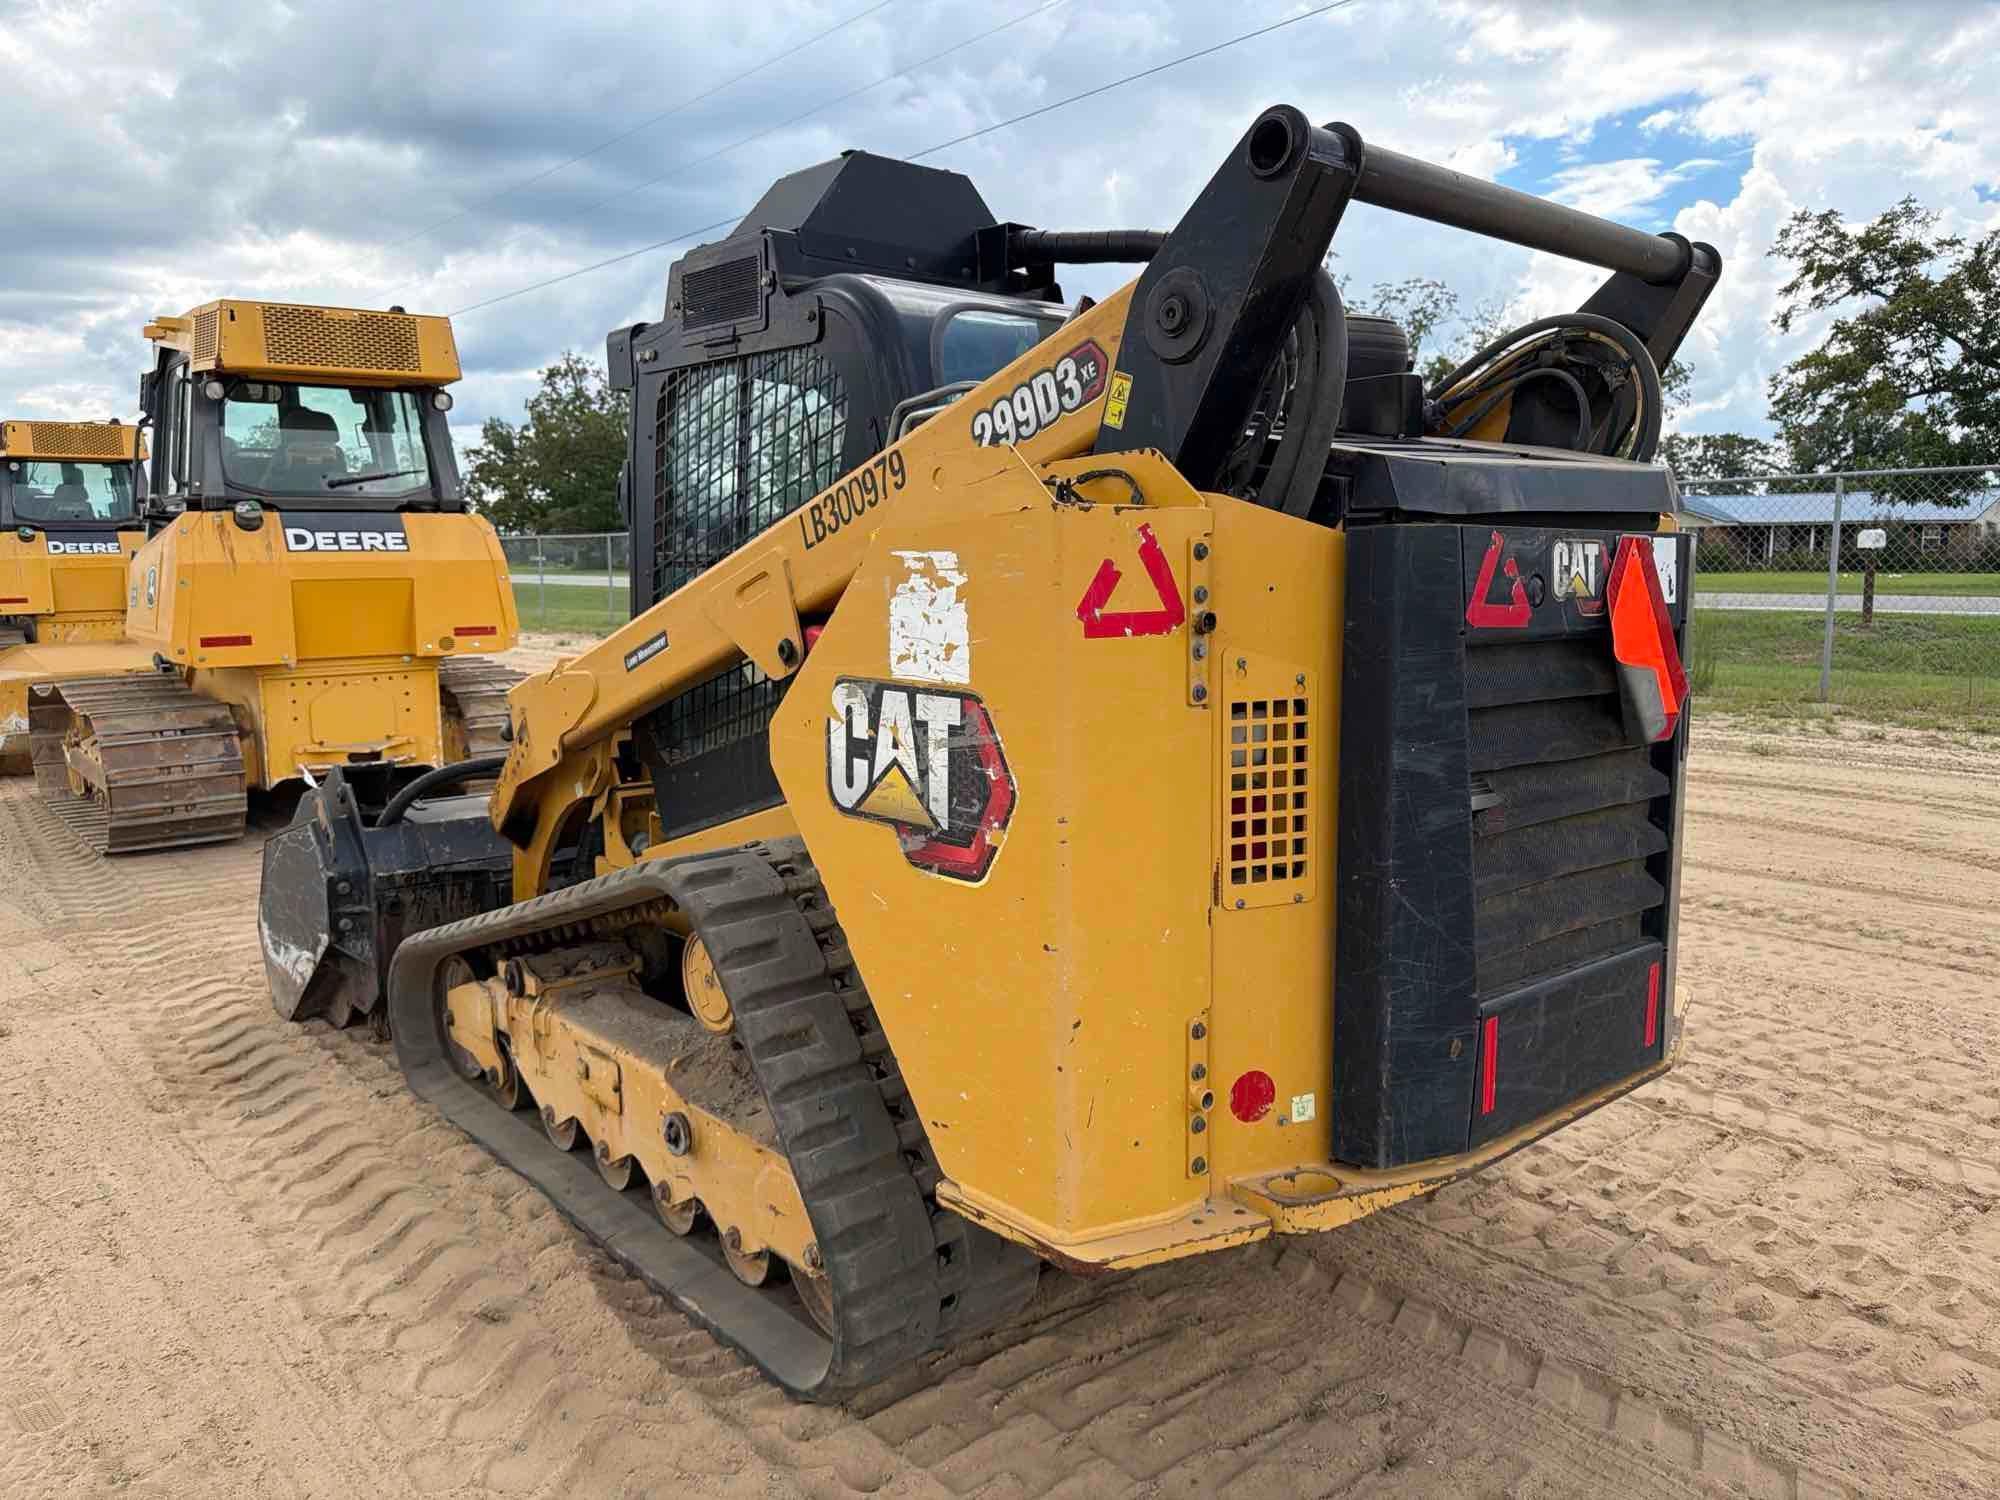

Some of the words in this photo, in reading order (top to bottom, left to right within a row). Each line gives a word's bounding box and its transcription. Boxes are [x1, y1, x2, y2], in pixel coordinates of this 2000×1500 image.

[974, 357, 1082, 448] 299D3
[1080, 361, 1096, 382] XE
[799, 449, 906, 550] LB300979
[47, 541, 120, 553] DEERE
[285, 528, 408, 551] DEERE
[1553, 541, 1600, 598] CAT
[830, 683, 961, 831] CAT
